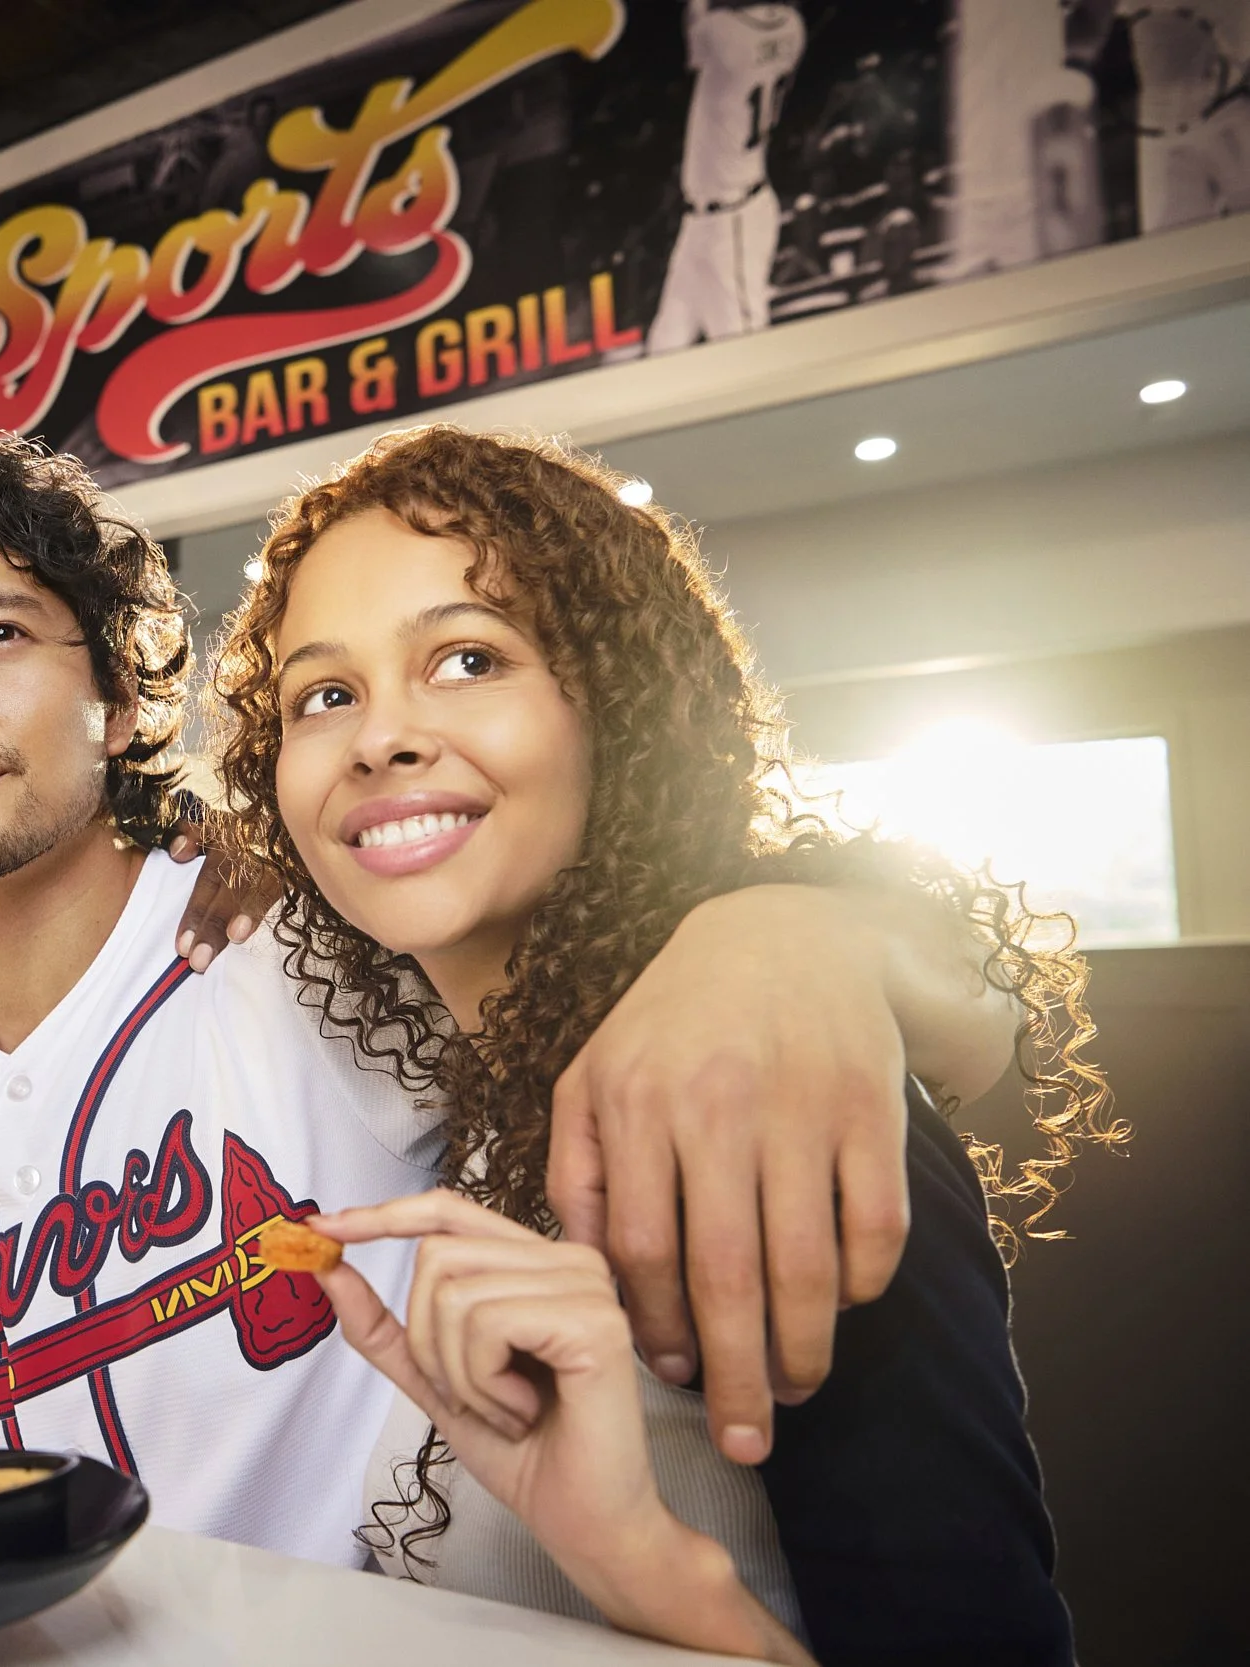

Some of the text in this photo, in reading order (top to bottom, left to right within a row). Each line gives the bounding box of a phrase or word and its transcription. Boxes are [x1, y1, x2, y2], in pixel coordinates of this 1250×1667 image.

[198, 271, 642, 455] BAR & GRILL
